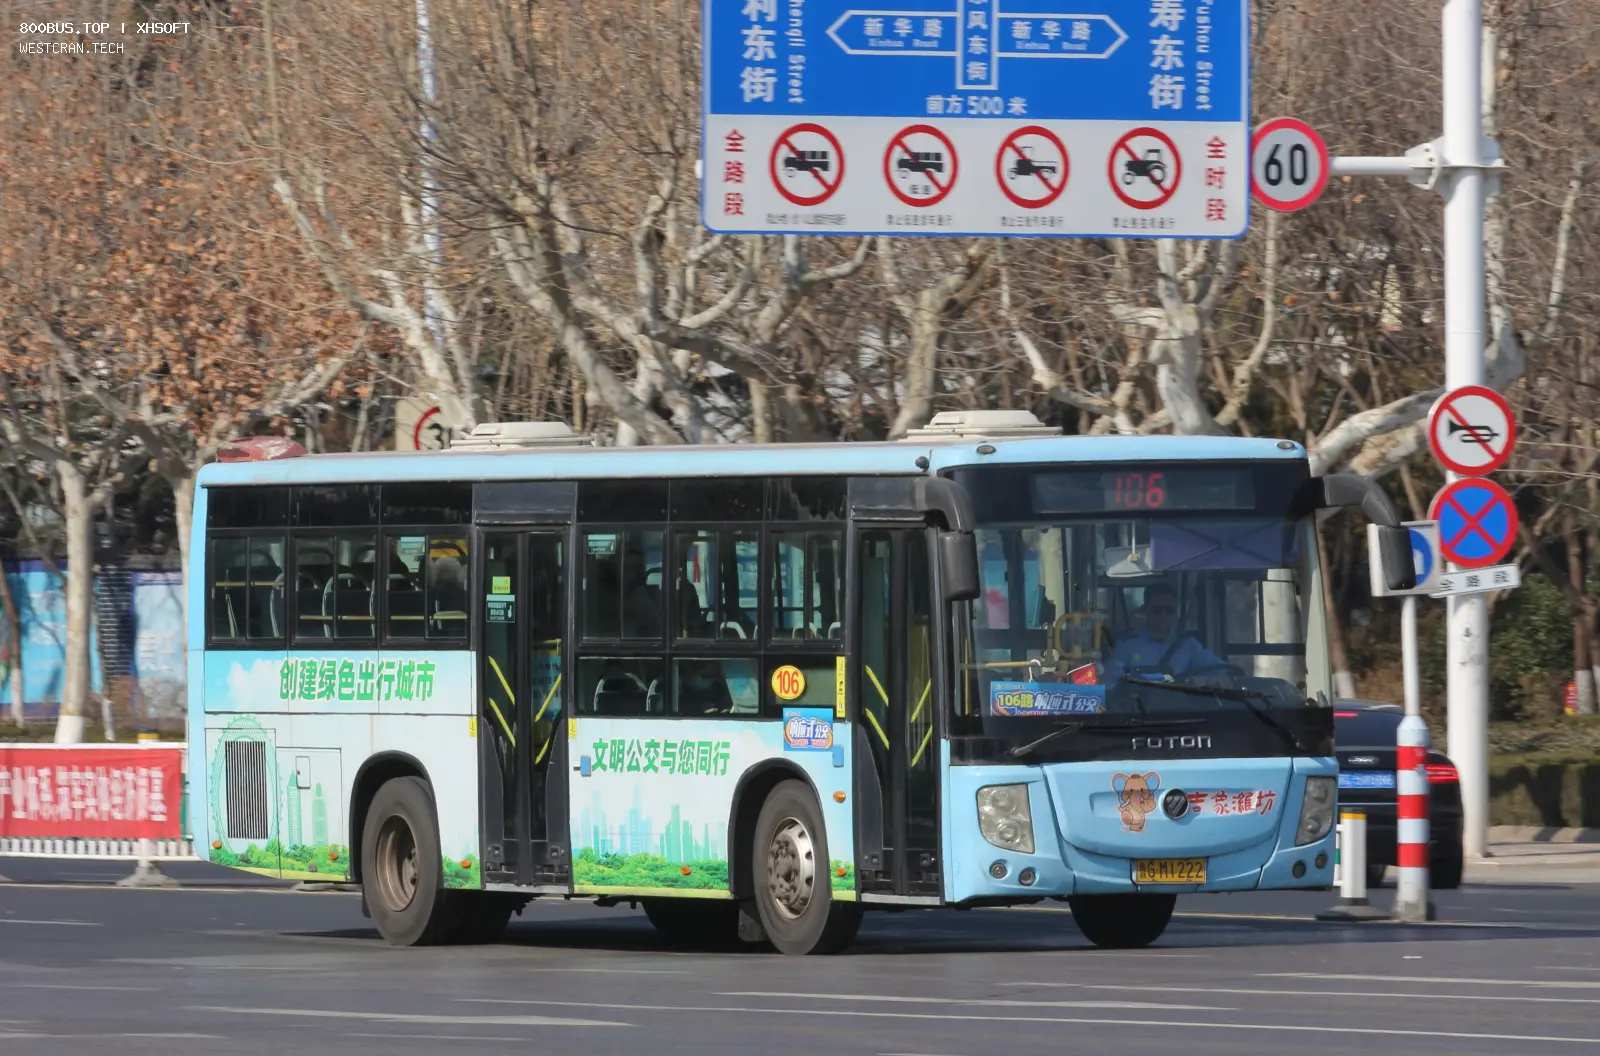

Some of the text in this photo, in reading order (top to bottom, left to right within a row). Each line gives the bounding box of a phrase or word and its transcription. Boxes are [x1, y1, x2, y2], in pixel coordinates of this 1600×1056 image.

[863, 17, 943, 38] 新华路
[1011, 20, 1091, 41] 新华路
[1195, 61, 1214, 111] Street
[1265, 143, 1308, 186] 60
[1113, 472, 1165, 508] 106
[279, 657, 436, 702] 创建绿色出行城市
[776, 670, 800, 695] 106
[591, 738, 731, 777] 文明公交与您同行
